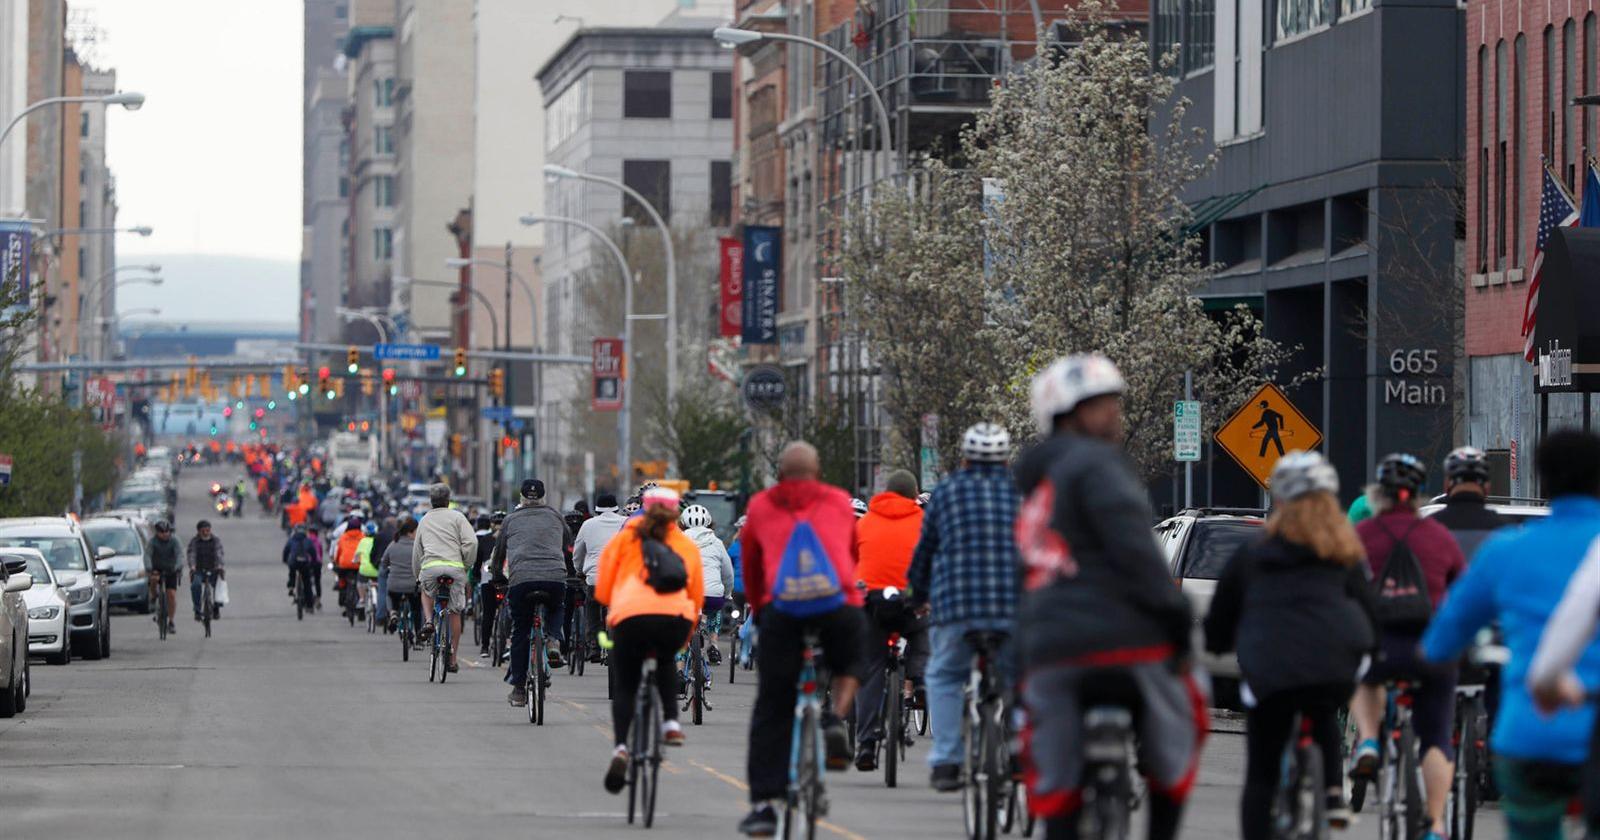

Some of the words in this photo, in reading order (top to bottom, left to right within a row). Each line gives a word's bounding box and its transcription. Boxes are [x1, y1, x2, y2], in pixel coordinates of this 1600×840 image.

[761, 269, 775, 339] SINATRA
[1390, 349, 1438, 373] 665
[1384, 380, 1446, 404] Main
[1176, 403, 1183, 416] 2
